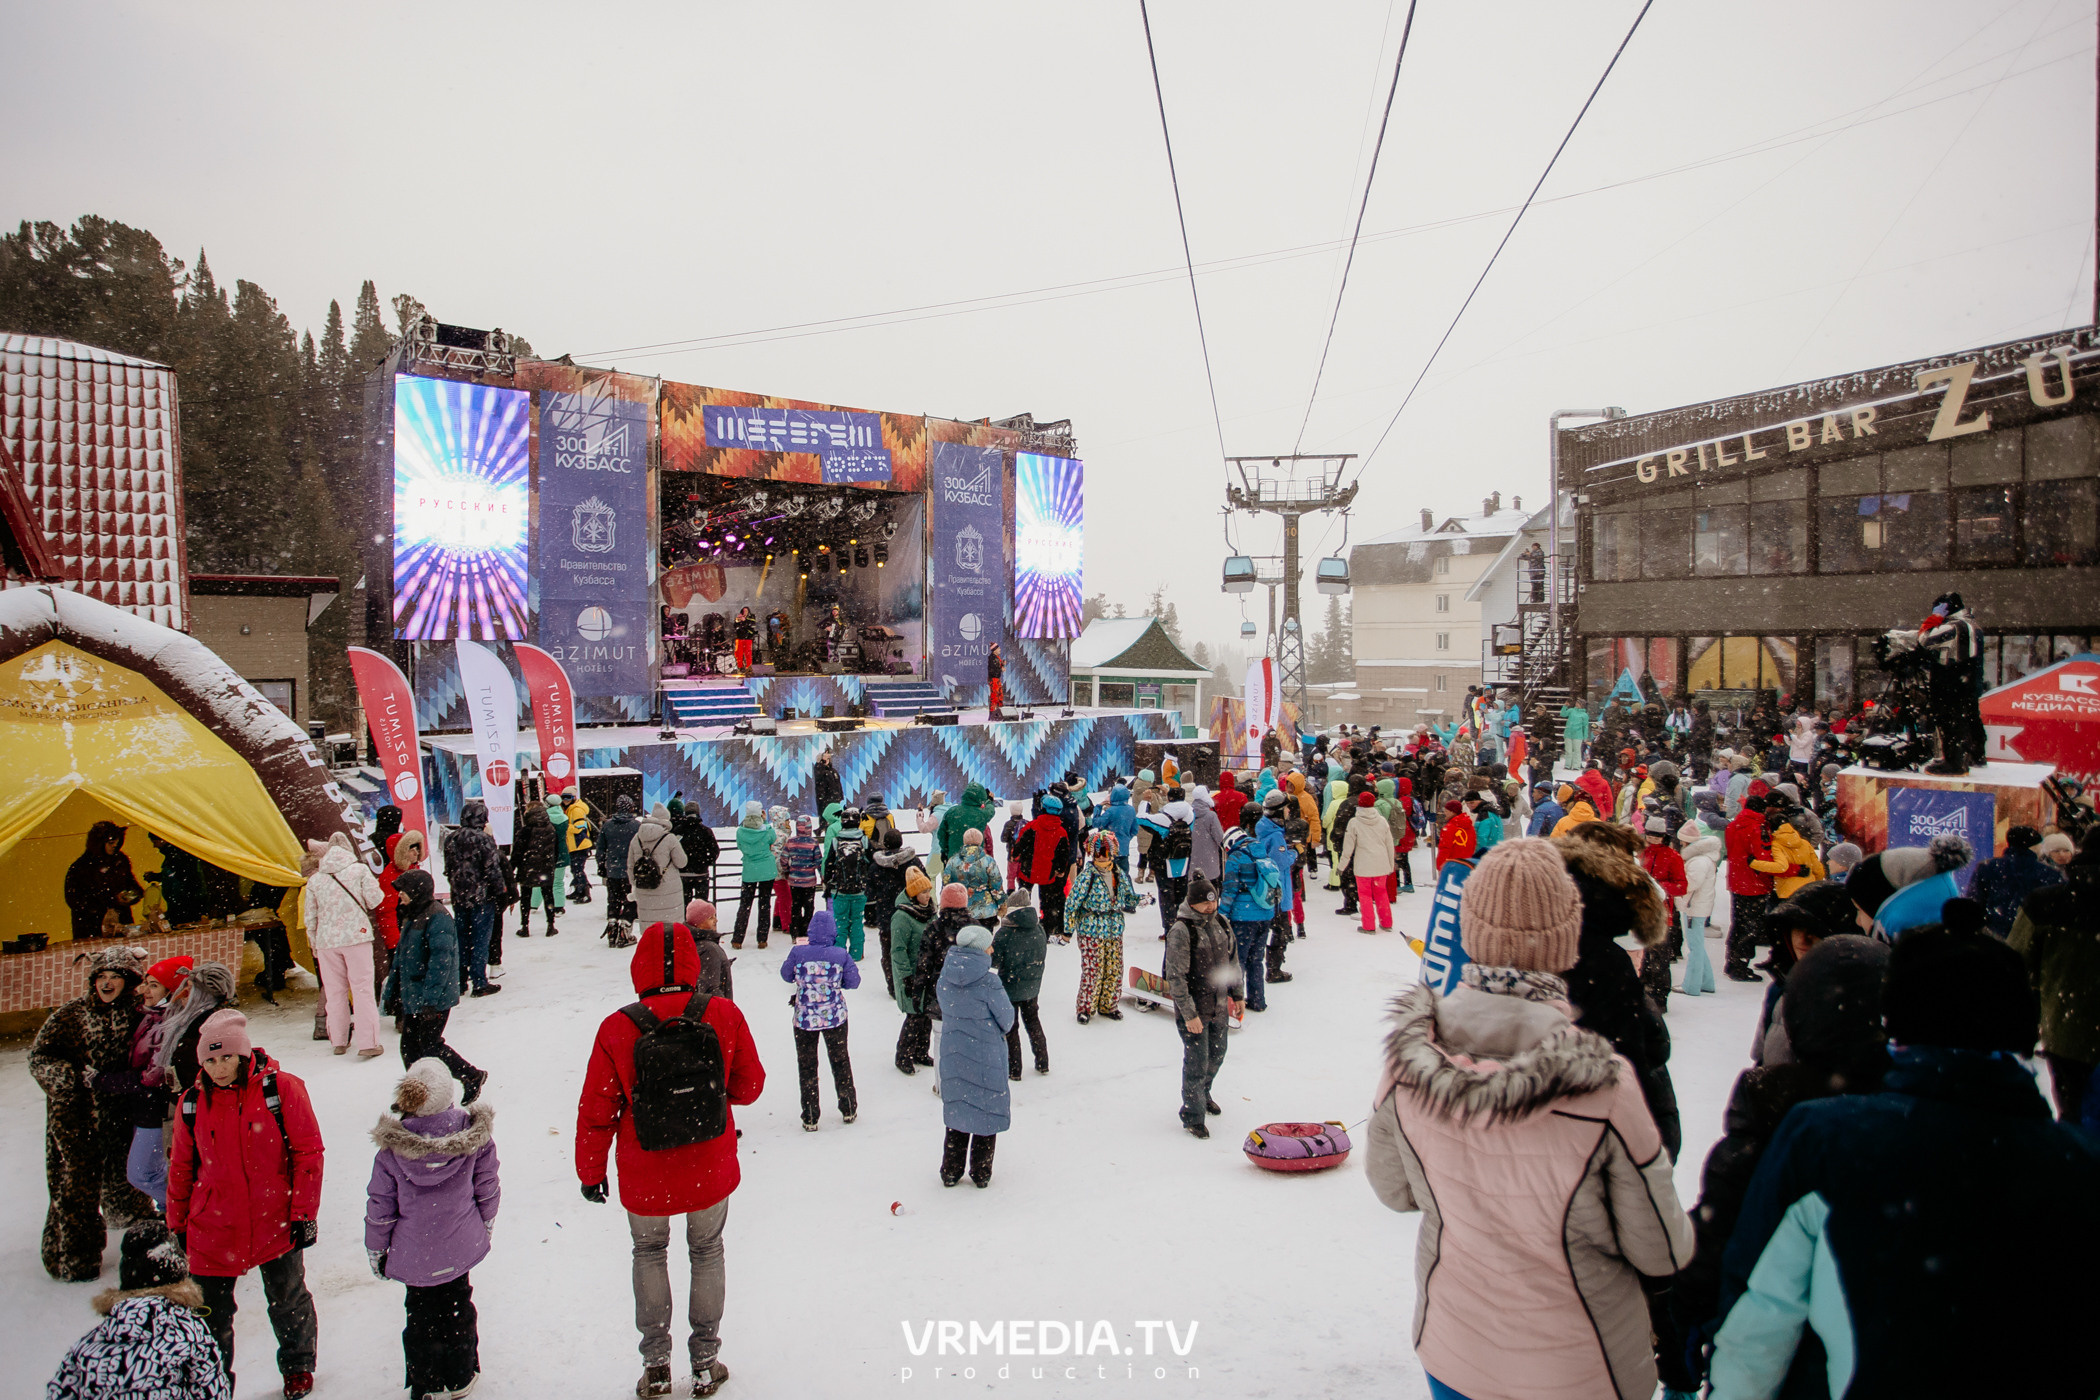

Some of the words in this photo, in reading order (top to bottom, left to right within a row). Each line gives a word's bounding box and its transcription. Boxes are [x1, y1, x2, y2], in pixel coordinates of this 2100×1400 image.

[556, 435, 587, 452] 300
[1636, 432, 1766, 484] GRILL
[1785, 406, 1878, 453] BAR
[556, 453, 631, 474] КУЗБАСС
[944, 477, 966, 489] 300
[944, 490, 992, 507] КУЗБАСС
[419, 498, 508, 513] РУССКИЕ
[1286, 527, 1298, 537] 10
[560, 559, 627, 571] Правительство
[573, 574, 616, 586] Кузбасса
[948, 574, 992, 585] Правительство
[956, 587, 984, 596] Кузбасса
[576, 664, 613, 673] HOTELS
[2011, 701, 2074, 713] МЕДИА
[1910, 815, 1935, 825] 300
[1910, 825, 1968, 839] КУЗБАСС
[660, 985, 681, 993] Canon
